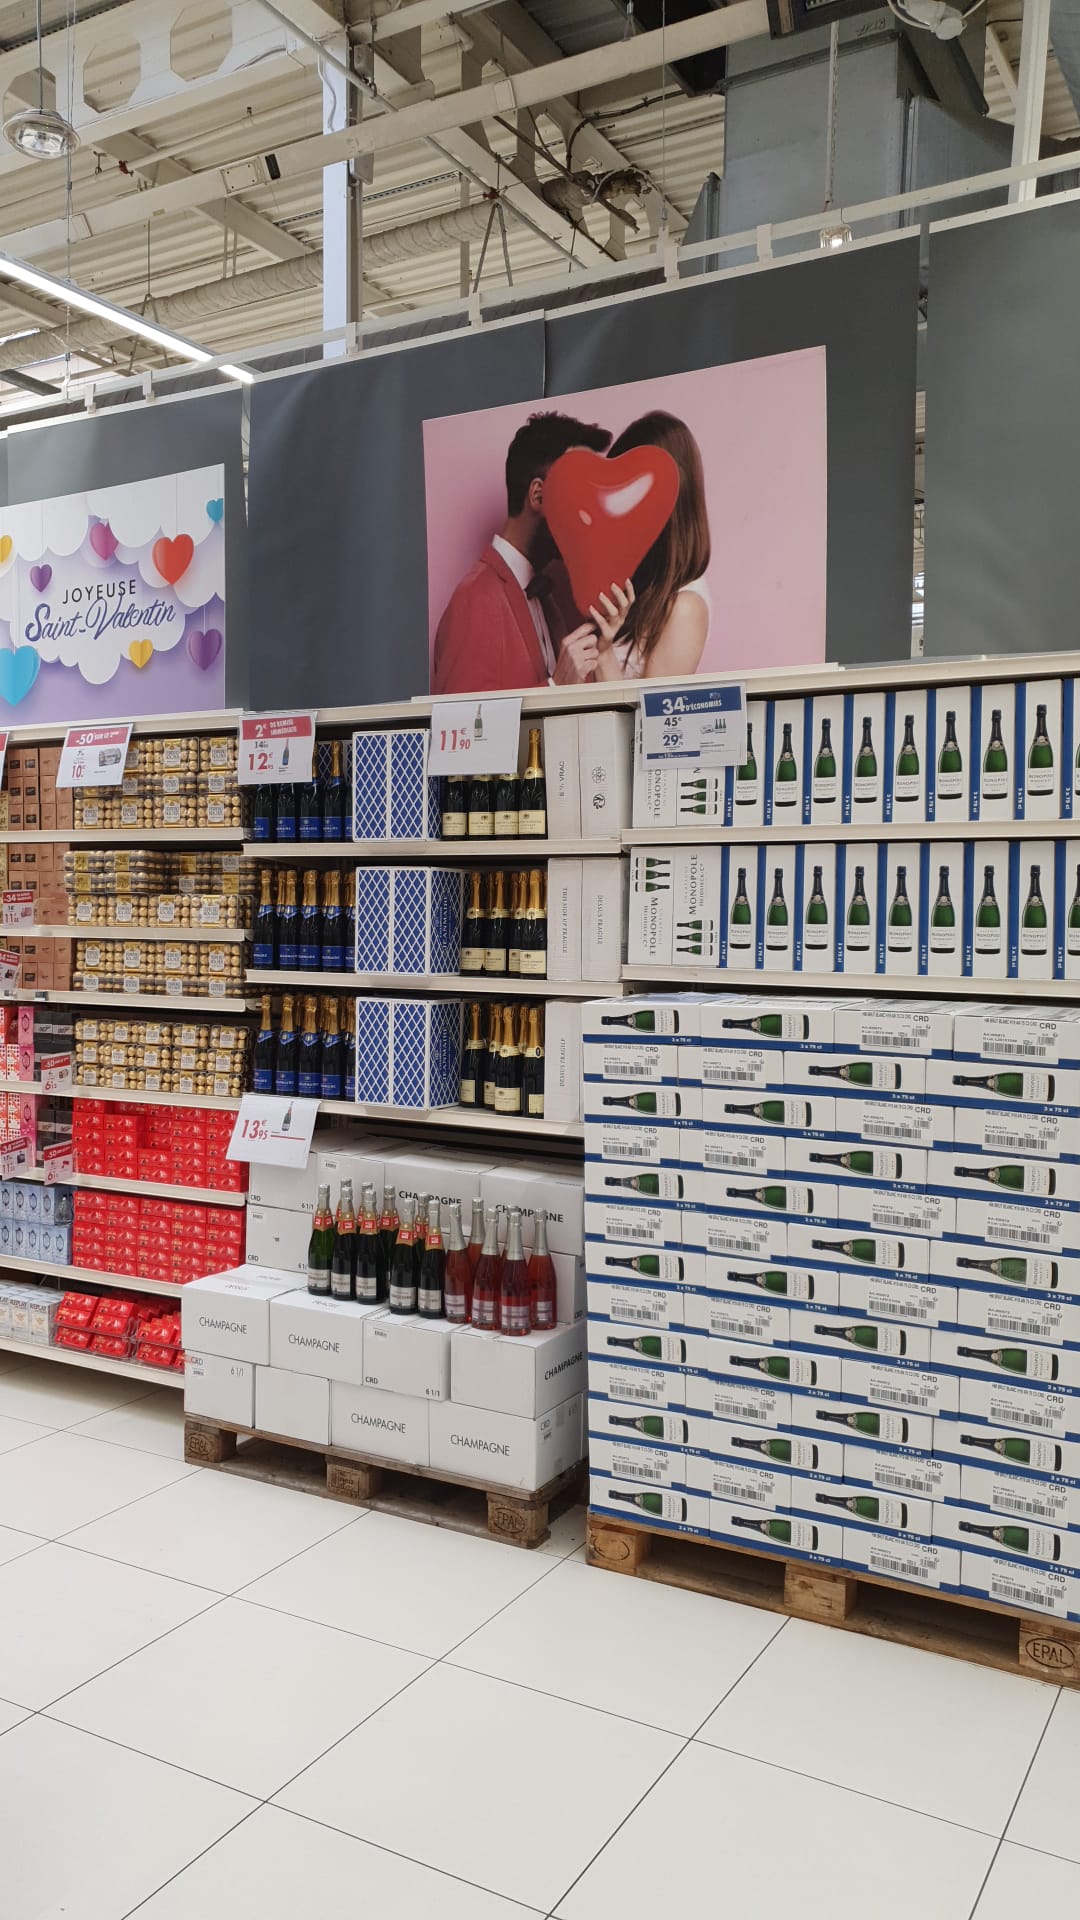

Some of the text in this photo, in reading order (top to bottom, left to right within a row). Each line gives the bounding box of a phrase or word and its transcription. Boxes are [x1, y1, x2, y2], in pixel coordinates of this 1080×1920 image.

[62, 579, 136, 604] JOYEUSE
[25, 593, 176, 642] Saint-Valentin
[664, 716, 682, 726] 45€
[654, 768, 662, 820] ONOPOLE
[688, 854, 698, 915] MONOPOLE
[650, 897, 658, 956] MONOPOLE
[1039, 1022, 1056, 1030] CRD
[1040, 1116, 1058, 1124] CRD
[399, 1190, 462, 1206] CHAPAGNE
[924, 1197, 940, 1205] CRD
[496, 1204, 564, 1222] CHMPNE
[1043, 1210, 1060, 1218] CRD
[920, 1286, 936, 1294] CRD
[756, 1305, 770, 1313] CRD
[1043, 1302, 1061, 1311] CRD
[199, 1317, 248, 1334] CHAMPAGNE
[288, 1334, 340, 1352] CHAMPAGNE
[191, 1356, 203, 1366] CRD
[544, 1352, 583, 1380] CHAMPAGNE
[230, 1367, 235, 1375] 6
[651, 1370, 664, 1378] CRD
[365, 1376, 378, 1384] CRD
[921, 1374, 938, 1383] CRD
[761, 1389, 775, 1397] CRD
[1046, 1394, 1064, 1404] CRD
[351, 1413, 406, 1433] CHAMPAGNE
[450, 1435, 510, 1456] CHAMPAGNE
[655, 1450, 668, 1458] CRD
[926, 1460, 942, 1470] CRD
[759, 1471, 774, 1480] CRD
[1049, 1484, 1066, 1493] CRD
[921, 1545, 938, 1555] CRD
[1048, 1573, 1065, 1583] CRD
[1033, 1642, 1067, 1665] EPAL
